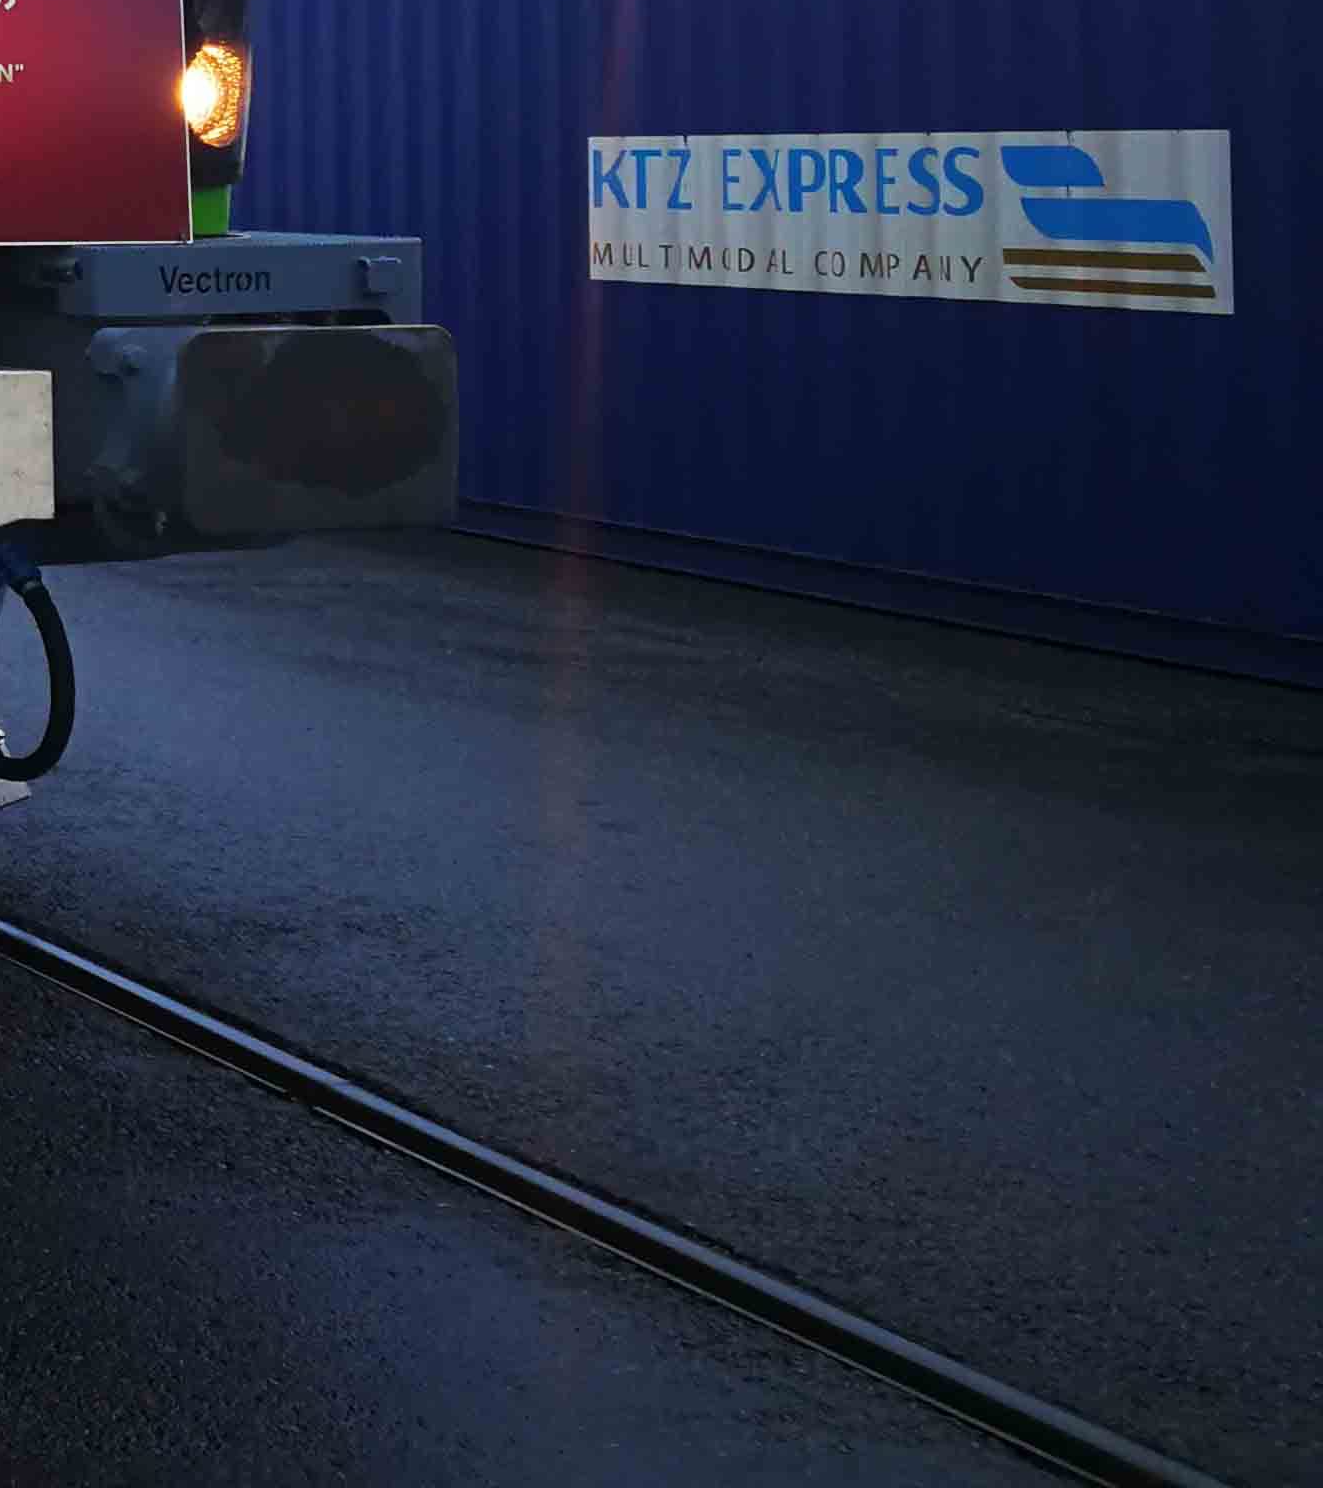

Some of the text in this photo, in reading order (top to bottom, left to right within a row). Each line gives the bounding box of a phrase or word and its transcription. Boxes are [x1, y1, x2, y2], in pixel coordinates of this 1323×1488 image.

[592, 146, 985, 216] KTZ EXPRESS
[158, 264, 272, 294] Vectron
[814, 249, 984, 283] COMPANY
